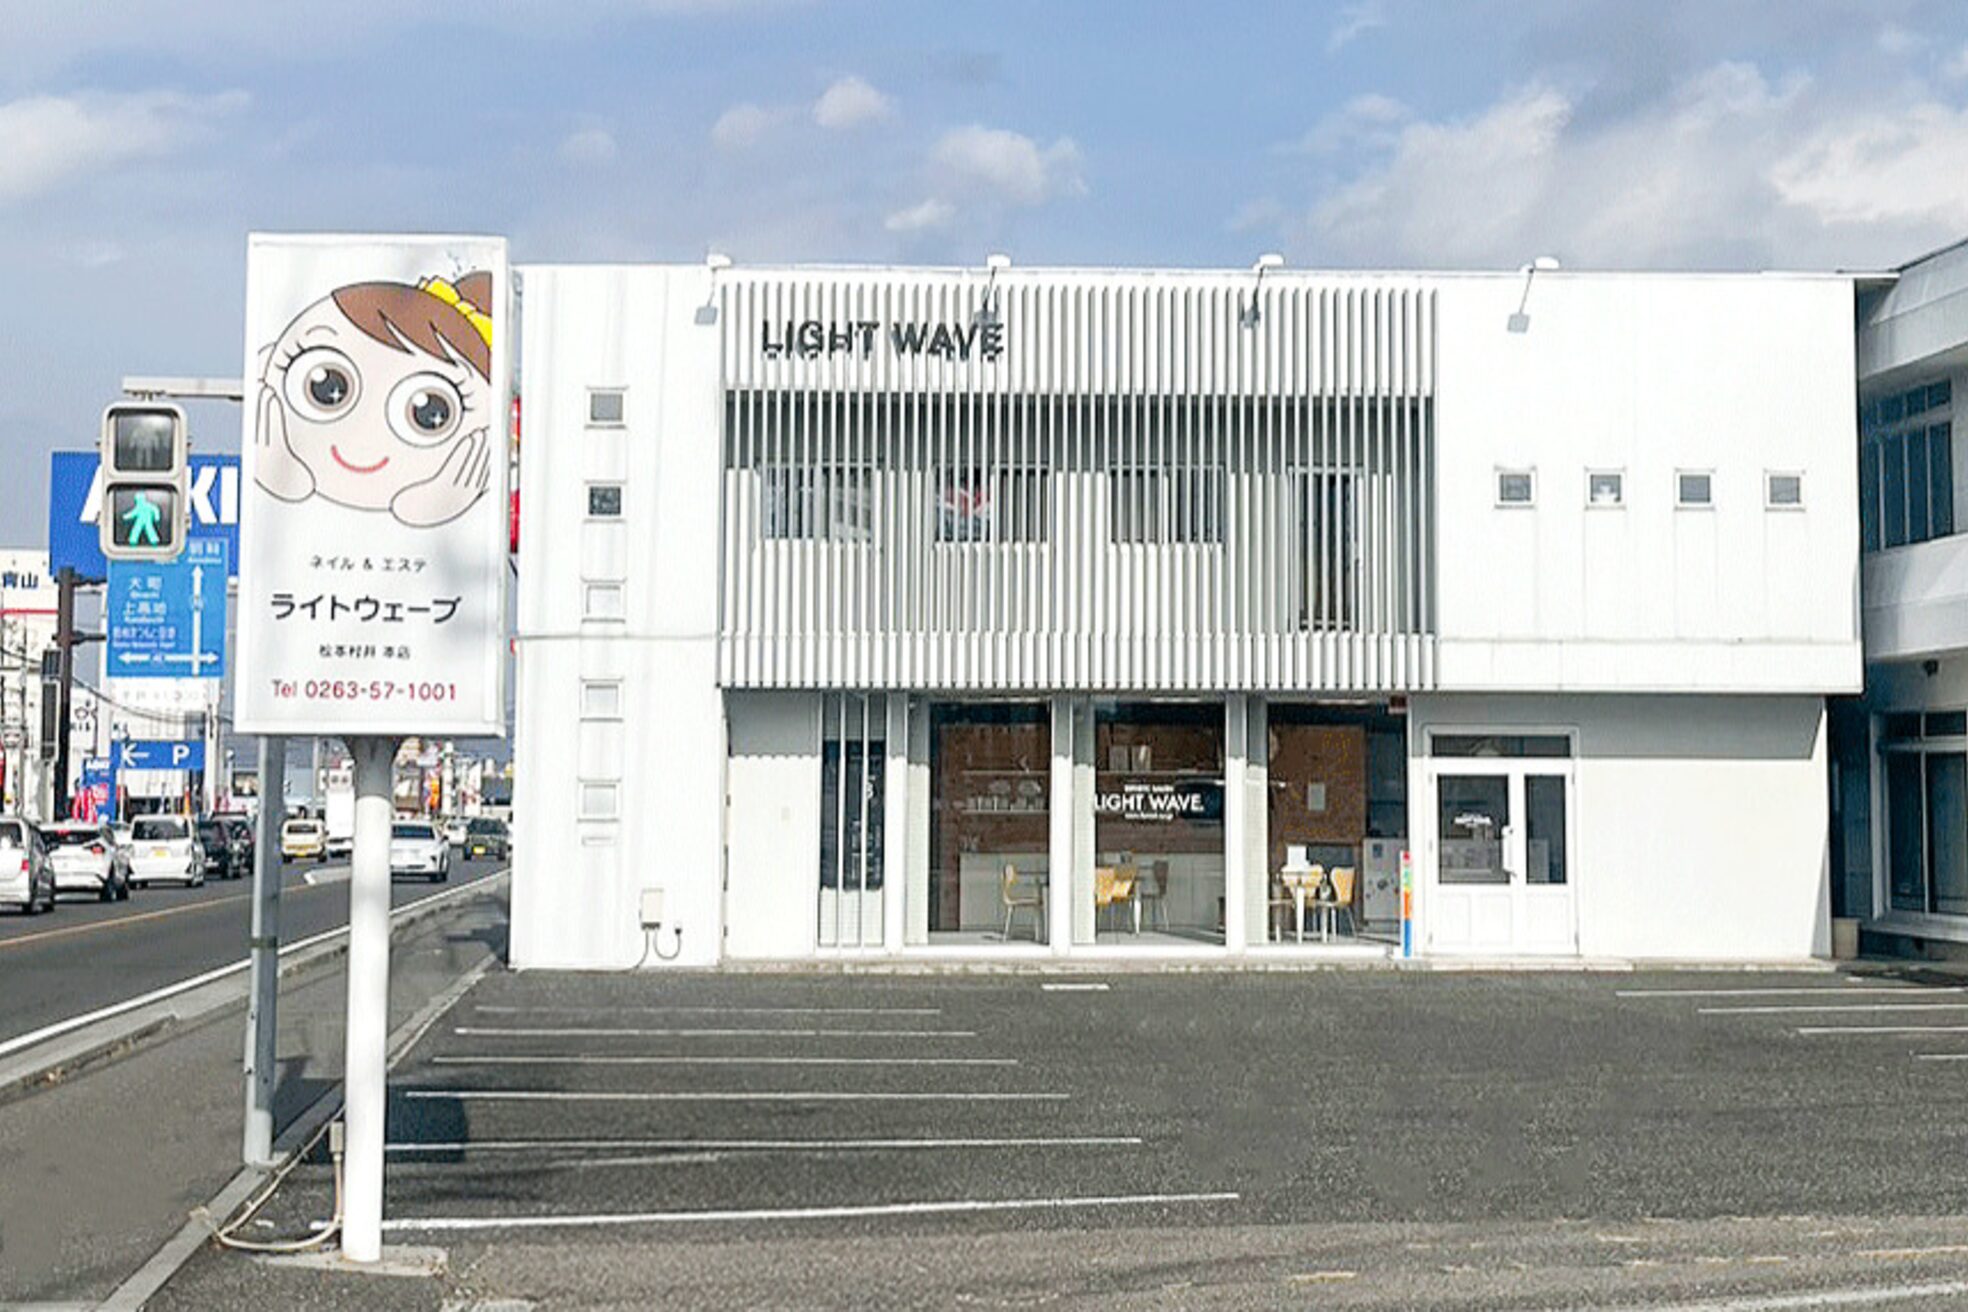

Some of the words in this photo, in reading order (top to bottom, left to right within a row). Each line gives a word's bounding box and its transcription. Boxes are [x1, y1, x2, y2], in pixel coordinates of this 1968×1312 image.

[762, 320, 880, 358] LIGHT
[892, 321, 1004, 359] WAVE
[310, 555, 355, 572] ネイル
[363, 557, 374, 571] &
[383, 557, 427, 573] エステ
[271, 679, 297, 699] Tel
[305, 680, 457, 701] 0263-57-1001
[172, 744, 190, 766] P
[1094, 793, 1145, 811] LIGHT
